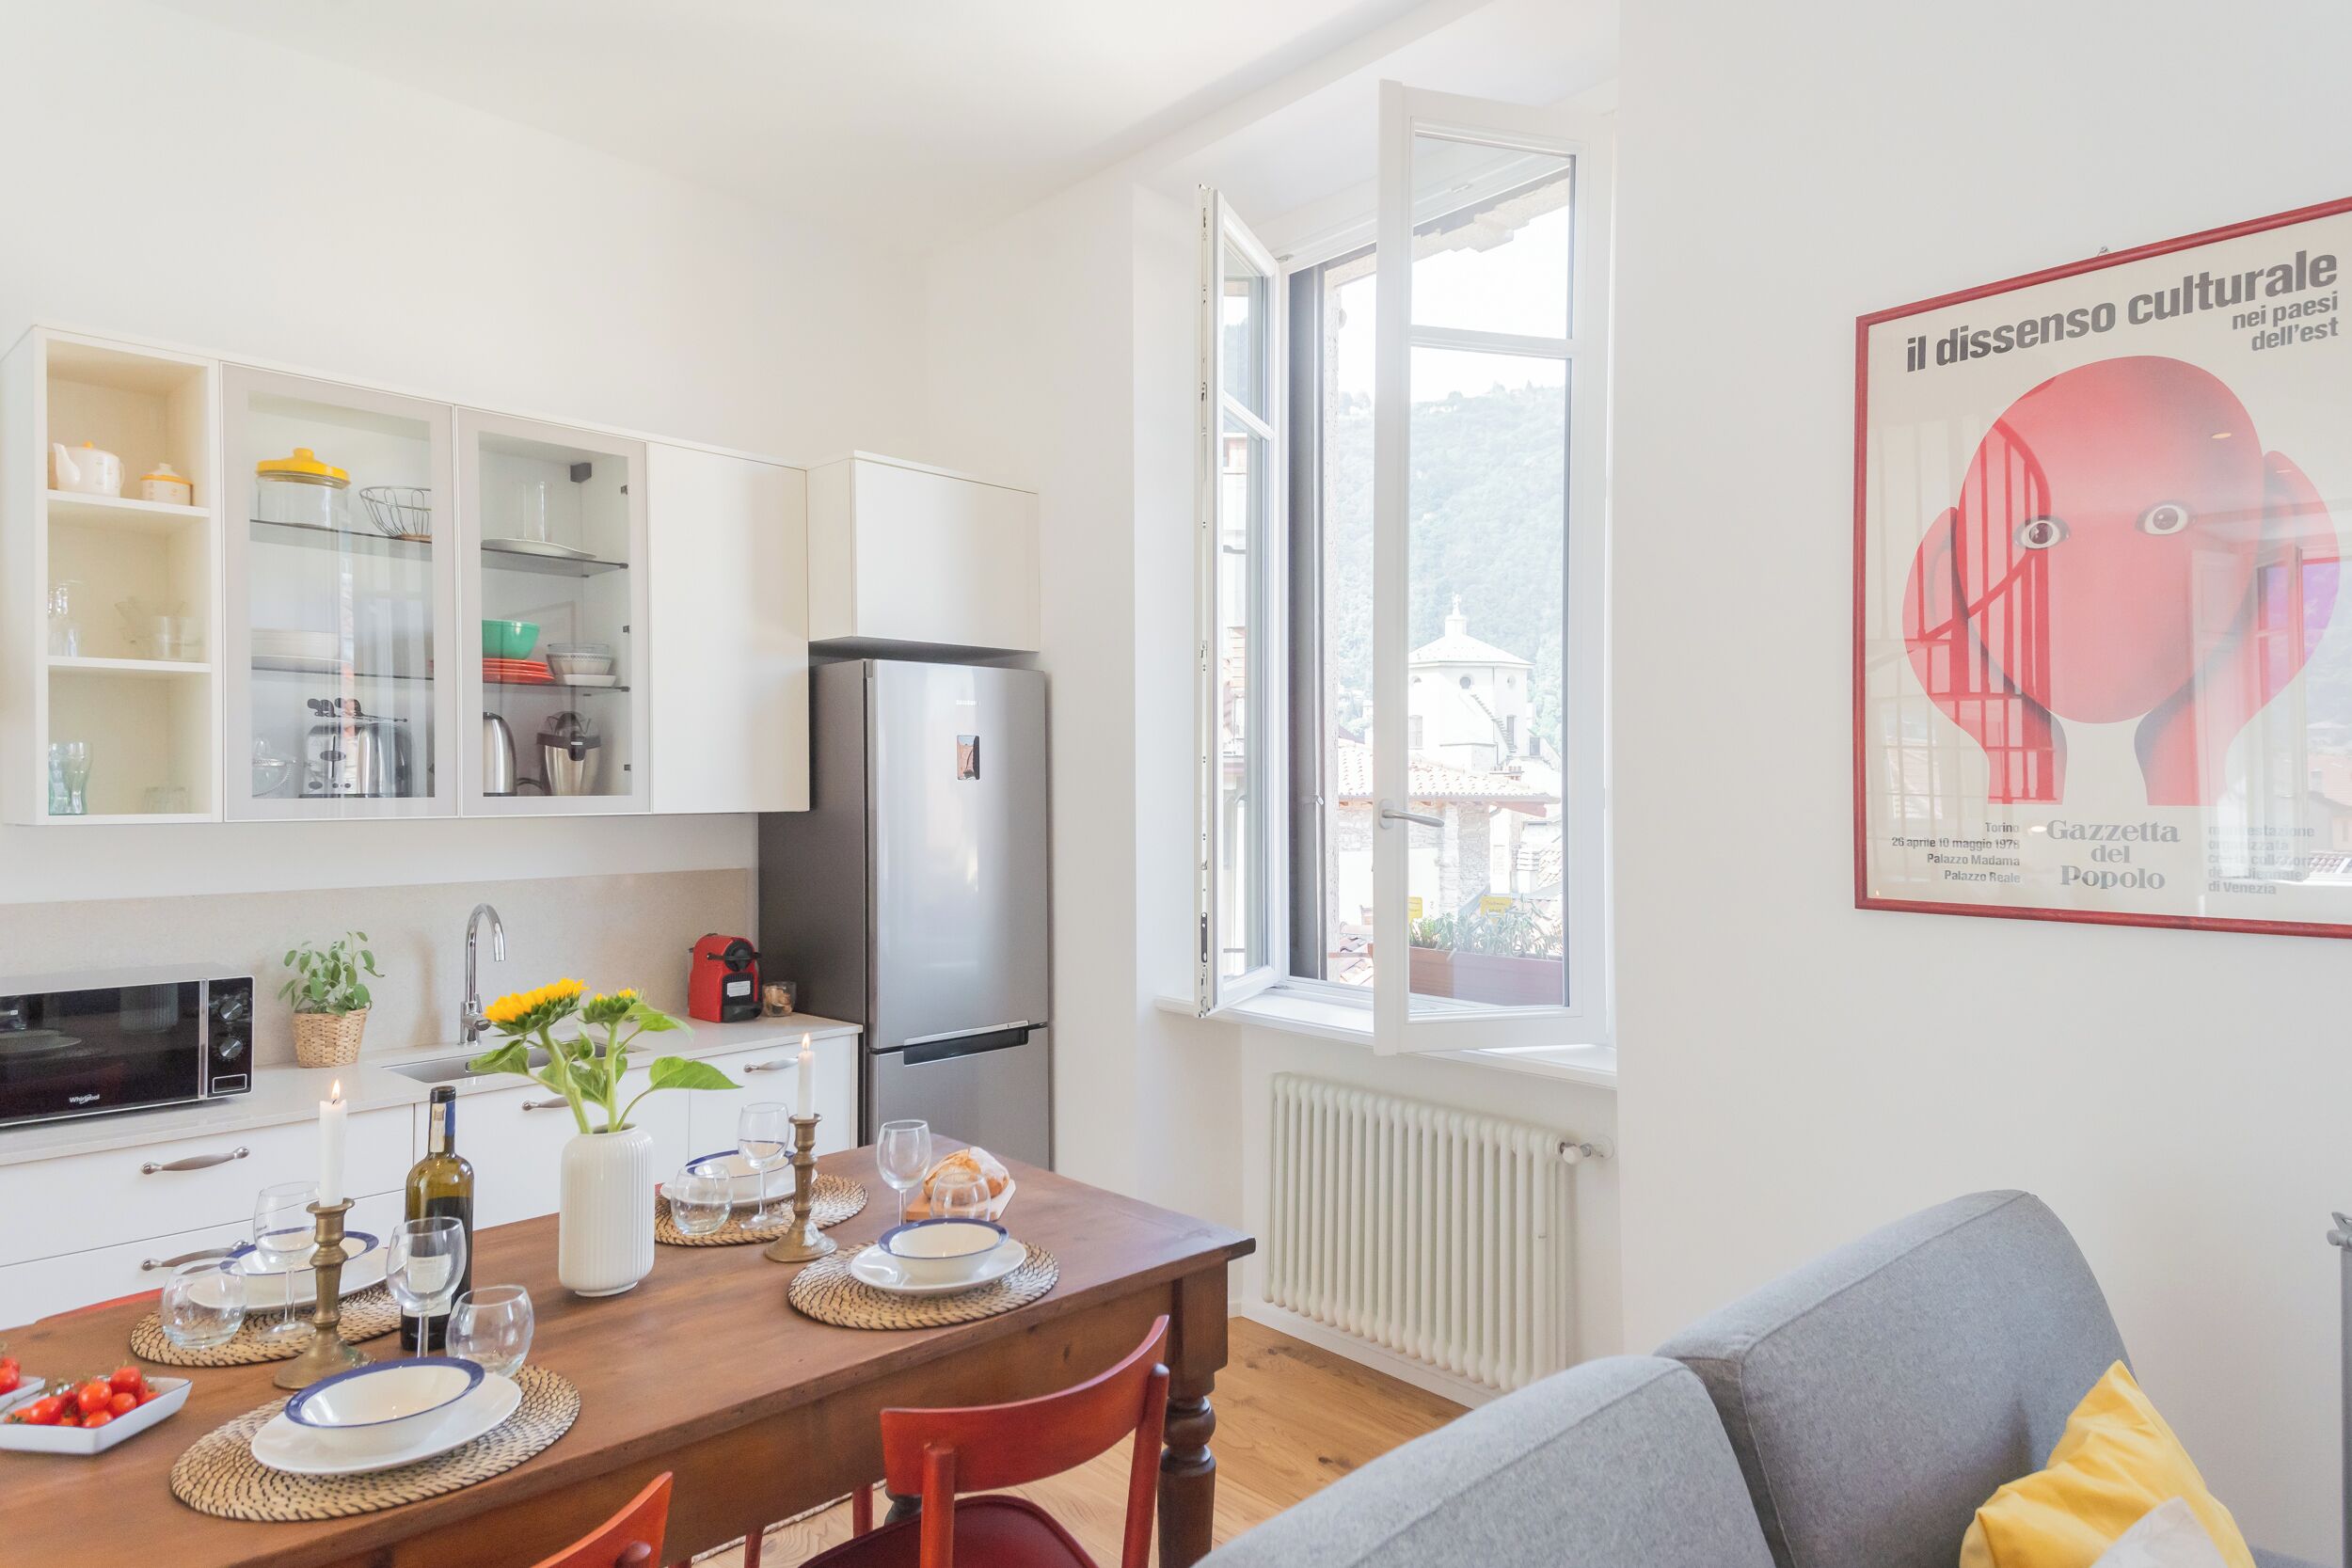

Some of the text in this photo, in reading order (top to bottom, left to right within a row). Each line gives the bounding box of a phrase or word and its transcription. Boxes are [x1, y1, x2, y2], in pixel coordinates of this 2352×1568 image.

[1907, 249, 2338, 372] il dissenso culturale
[2233, 291, 2338, 330] nei paesi
[2251, 316, 2339, 352] dell'est
[1985, 822, 2020, 833] Torino
[2046, 819, 2181, 843] Gazzetta
[1891, 836, 1905, 847] 26
[1906, 837, 1936, 850] aprile
[1939, 838, 1949, 847] 10
[1952, 838, 1993, 851] maggio
[1927, 853, 2021, 866] Palazzo Madama
[2090, 845, 2131, 863] del
[1944, 870, 2021, 883] Palazzo Reale
[2060, 864, 2166, 889] Popolo
[2208, 880, 2277, 895] di Venezia
